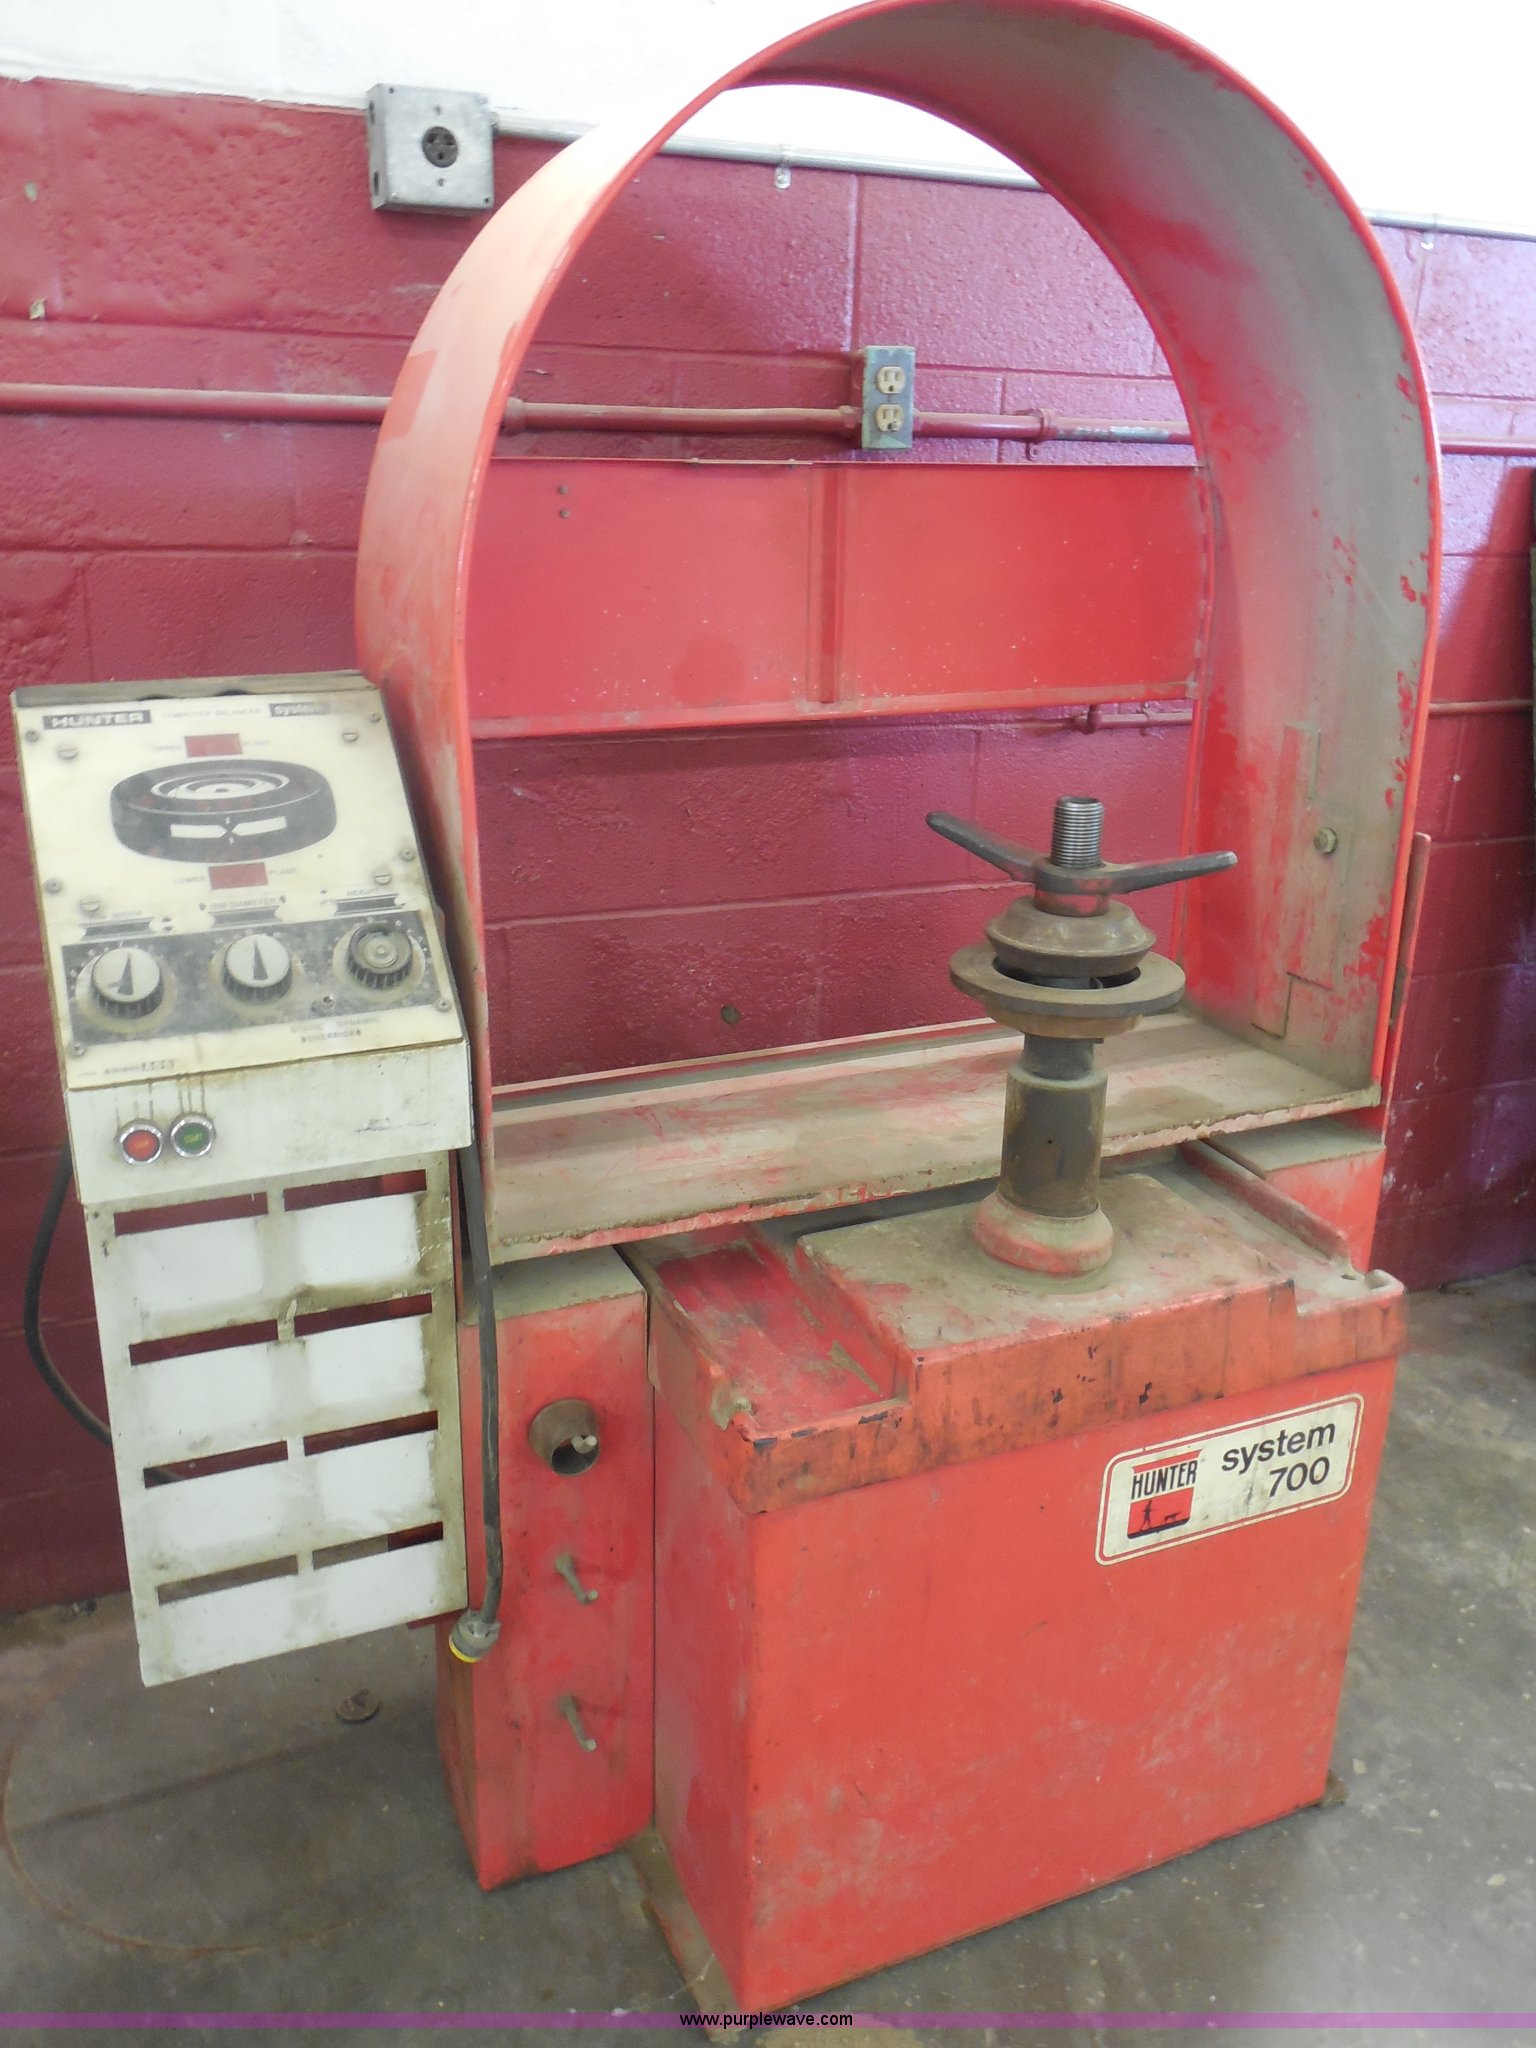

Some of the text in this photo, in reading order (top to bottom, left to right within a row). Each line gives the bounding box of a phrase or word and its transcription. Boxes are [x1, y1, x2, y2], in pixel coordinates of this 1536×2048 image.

[52, 712, 143, 727] HUNTER
[1221, 1422, 1336, 1476] system
[1131, 1460, 1198, 1500] HUNTER
[1268, 1456, 1331, 1497] 700
